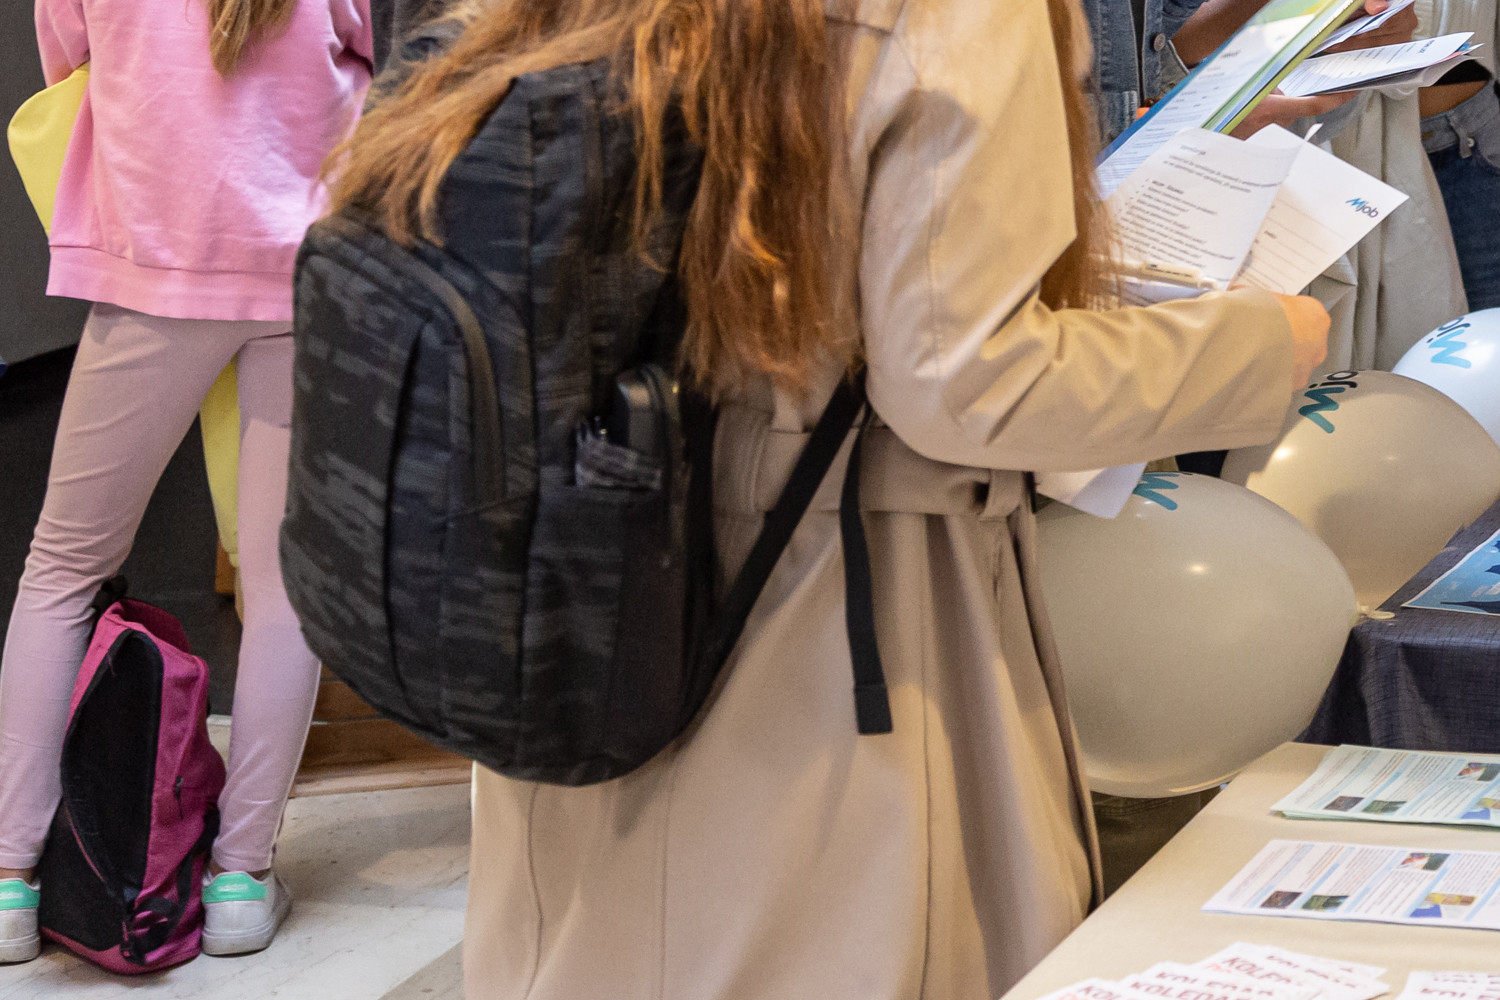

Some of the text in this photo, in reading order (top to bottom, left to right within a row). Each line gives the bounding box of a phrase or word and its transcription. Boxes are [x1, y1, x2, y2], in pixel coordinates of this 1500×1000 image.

[1345, 197, 1379, 218] Mjob
[1426, 316, 1472, 369] Mjo
[1298, 370, 1359, 434] Mjo
